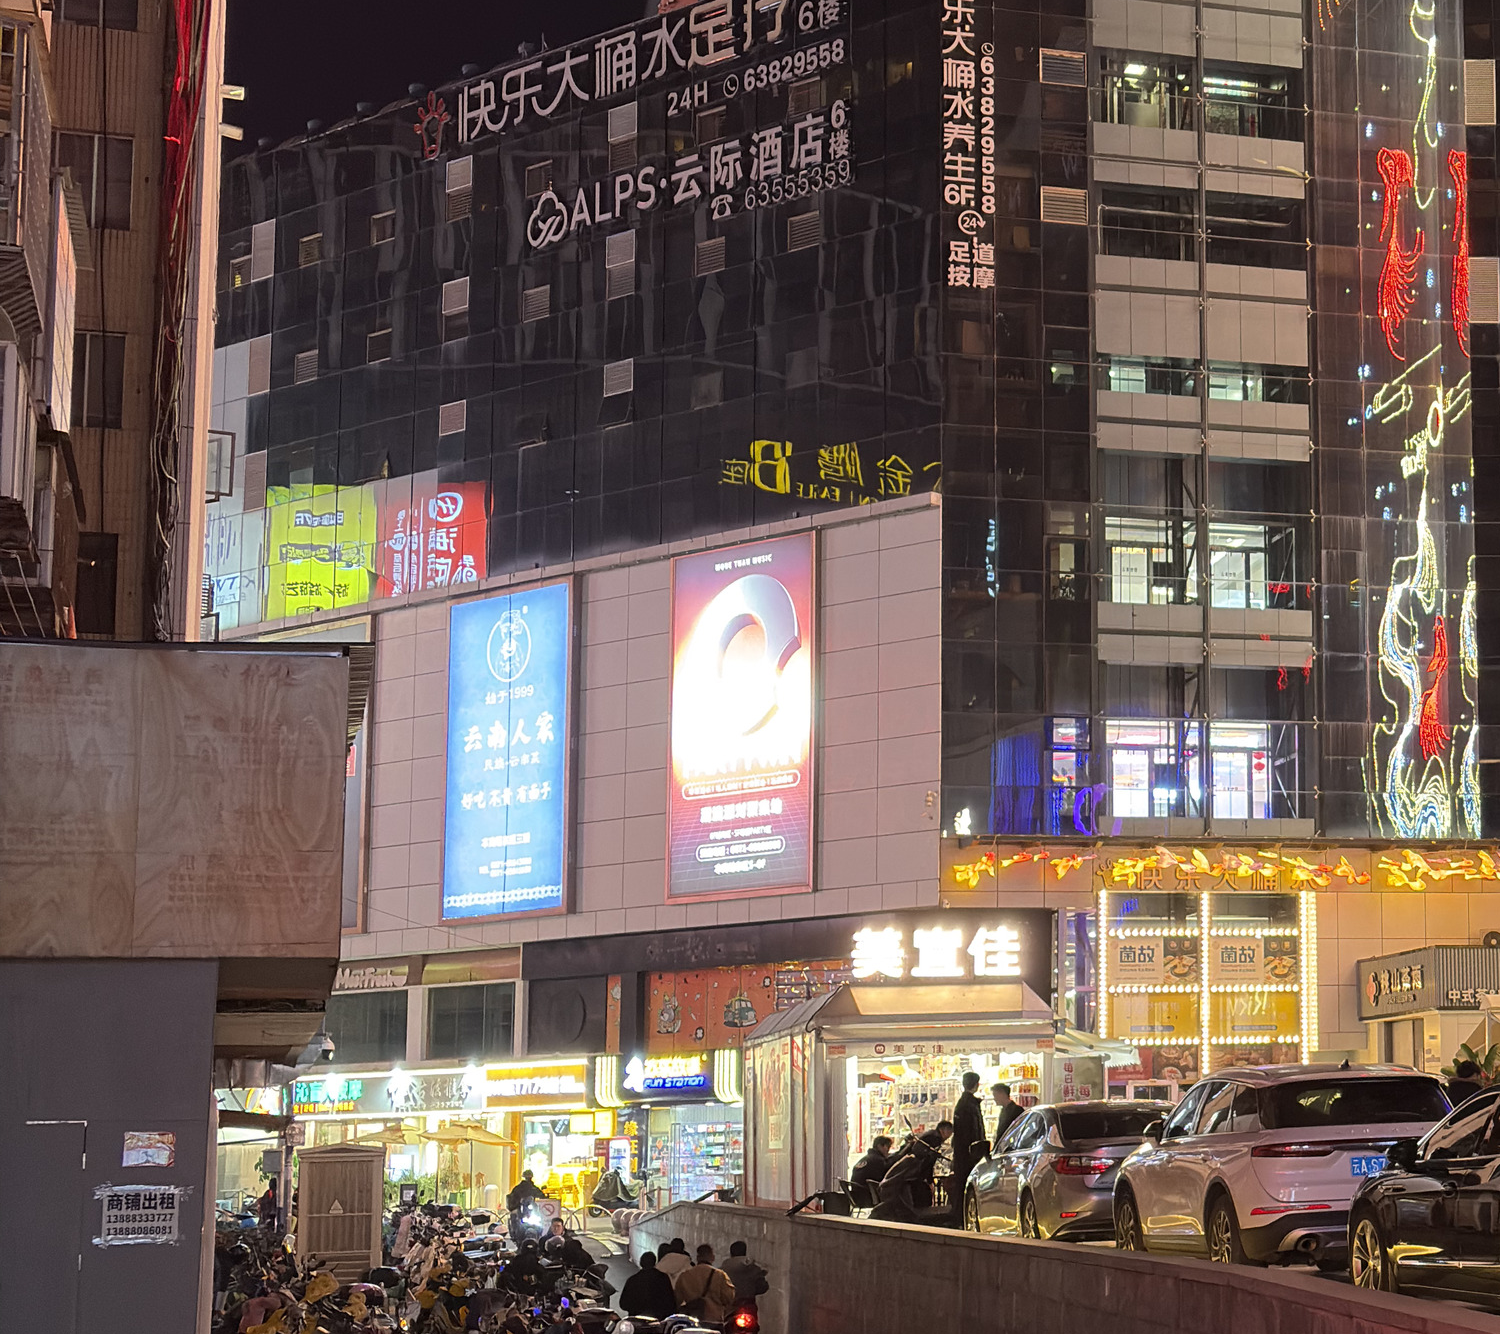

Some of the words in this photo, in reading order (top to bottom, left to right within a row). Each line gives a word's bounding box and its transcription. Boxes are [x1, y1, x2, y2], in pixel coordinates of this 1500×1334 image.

[668, 81, 708, 117] 24H
[743, 39, 843, 91] 63829558
[980, 56, 996, 214] 63829558
[745, 159, 851, 211] 63555359
[963, 216, 976, 228] 24
[464, 711, 554, 753] 云南人家
[851, 926, 1022, 978] 美宜佳
[1120, 946, 1156, 963] 菌故
[1220, 946, 1256, 963] 菌故
[1380, 964, 1424, 995] 桃山茶雨
[893, 1044, 945, 1054] 美宜佳
[106, 1192, 175, 1211] 商铺出租
[106, 1213, 174, 1224] 13888333727
[106, 1225, 172, 1236] 13888086081
